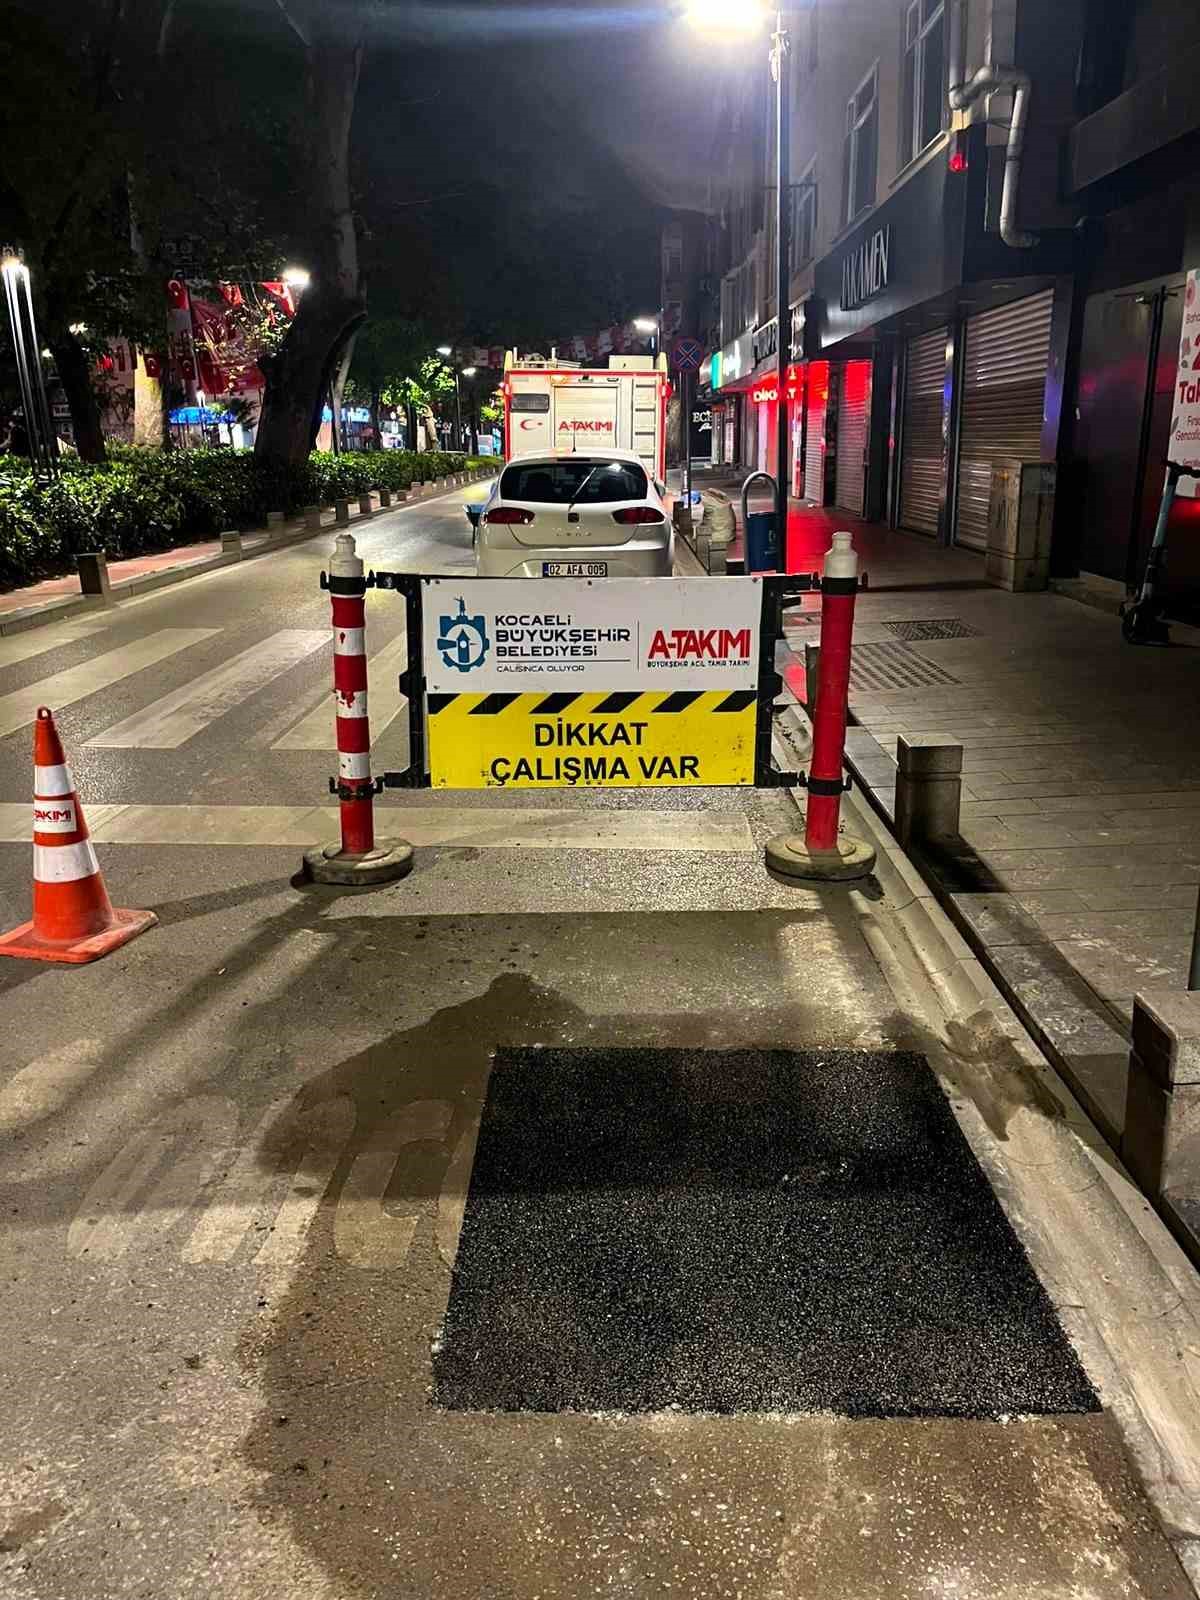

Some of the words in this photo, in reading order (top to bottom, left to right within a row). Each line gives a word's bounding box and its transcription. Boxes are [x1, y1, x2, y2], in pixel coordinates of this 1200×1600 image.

[558, 420, 613, 432] A-TAKIMI
[549, 564, 561, 575] 02
[567, 564, 583, 575] AFA
[648, 629, 751, 659] A-TAKIMI
[546, 664, 586, 673] OLUYOR
[534, 717, 649, 747] DİKKAT
[490, 756, 630, 786] ÇALIŞMA
[638, 755, 700, 780] VAR
